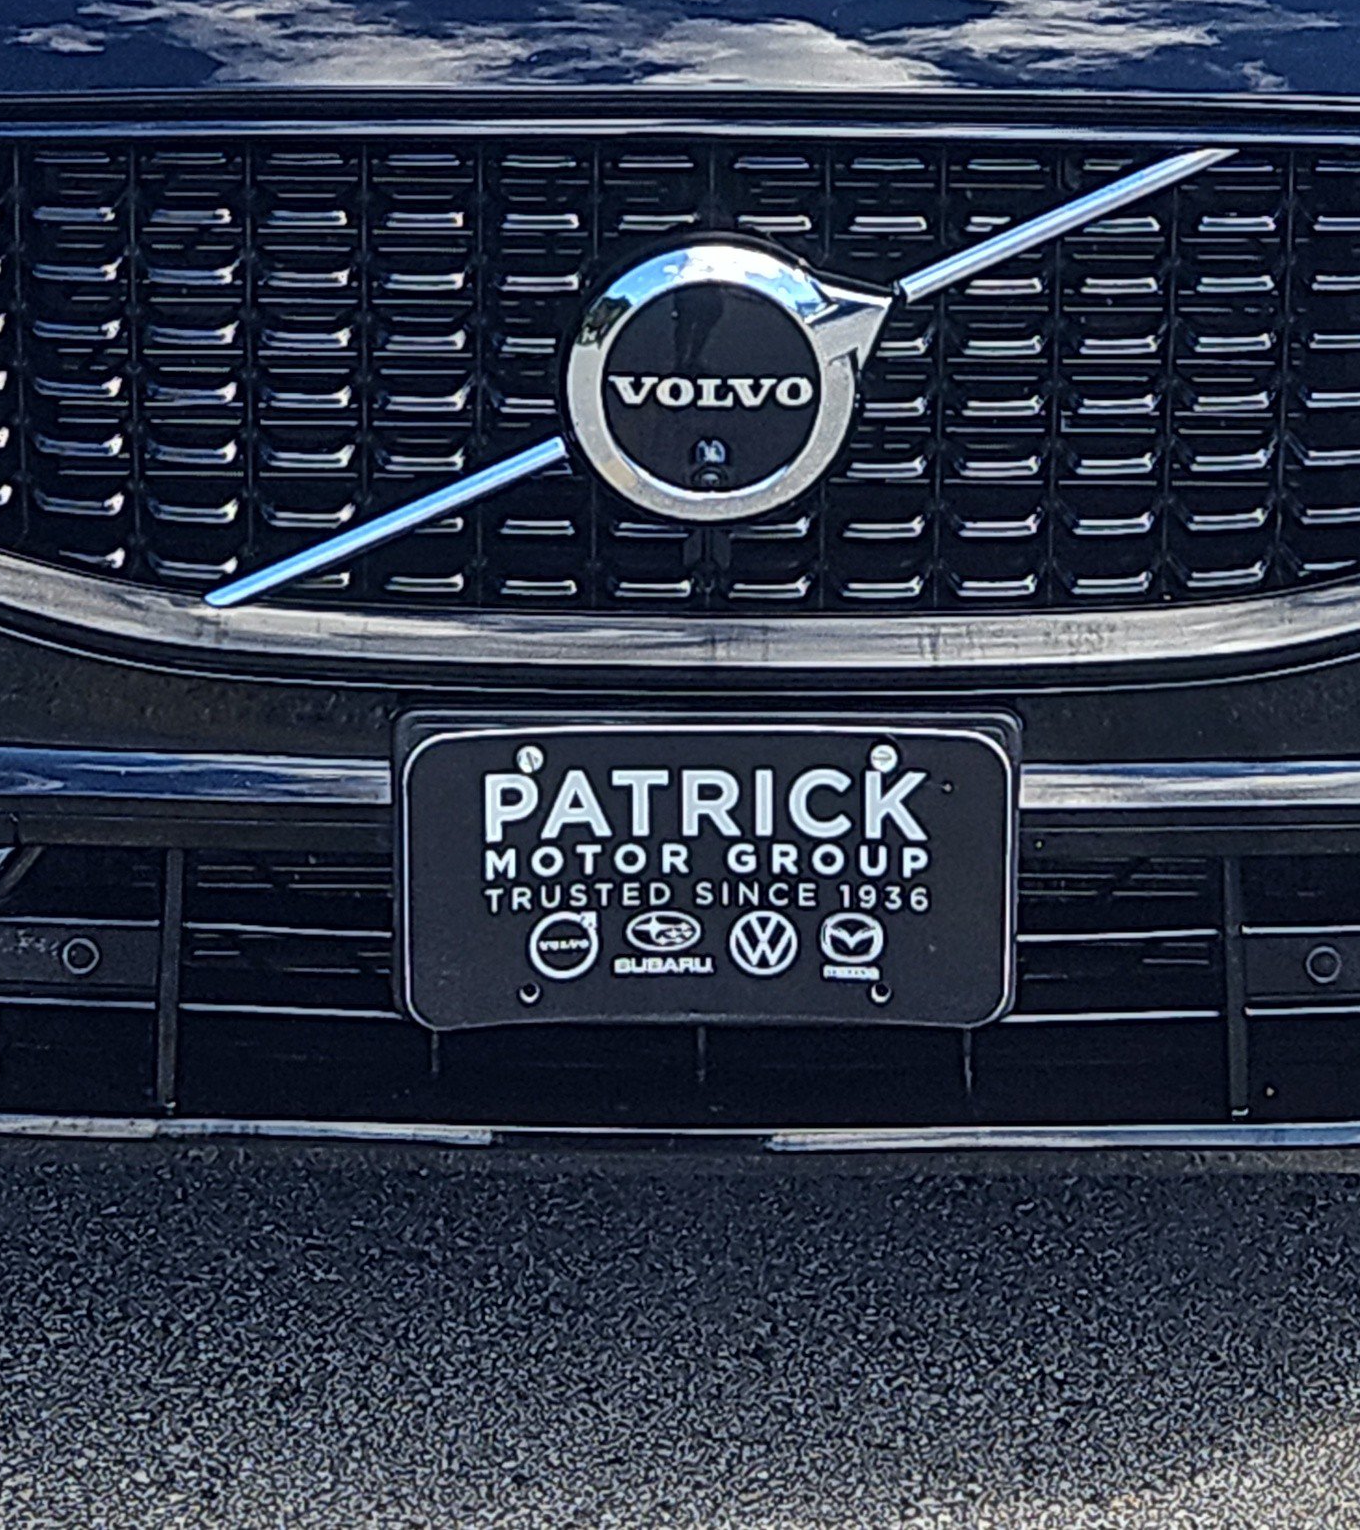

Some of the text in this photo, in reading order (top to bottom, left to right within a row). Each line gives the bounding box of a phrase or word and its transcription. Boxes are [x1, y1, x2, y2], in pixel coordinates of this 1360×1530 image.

[608, 376, 814, 408] VOLVO
[485, 769, 928, 843] PATRICK
[485, 843, 929, 881] MOTOR GROUP
[484, 881, 929, 913] TRUSTED SINCE 1936
[614, 957, 714, 974] SUBARU
